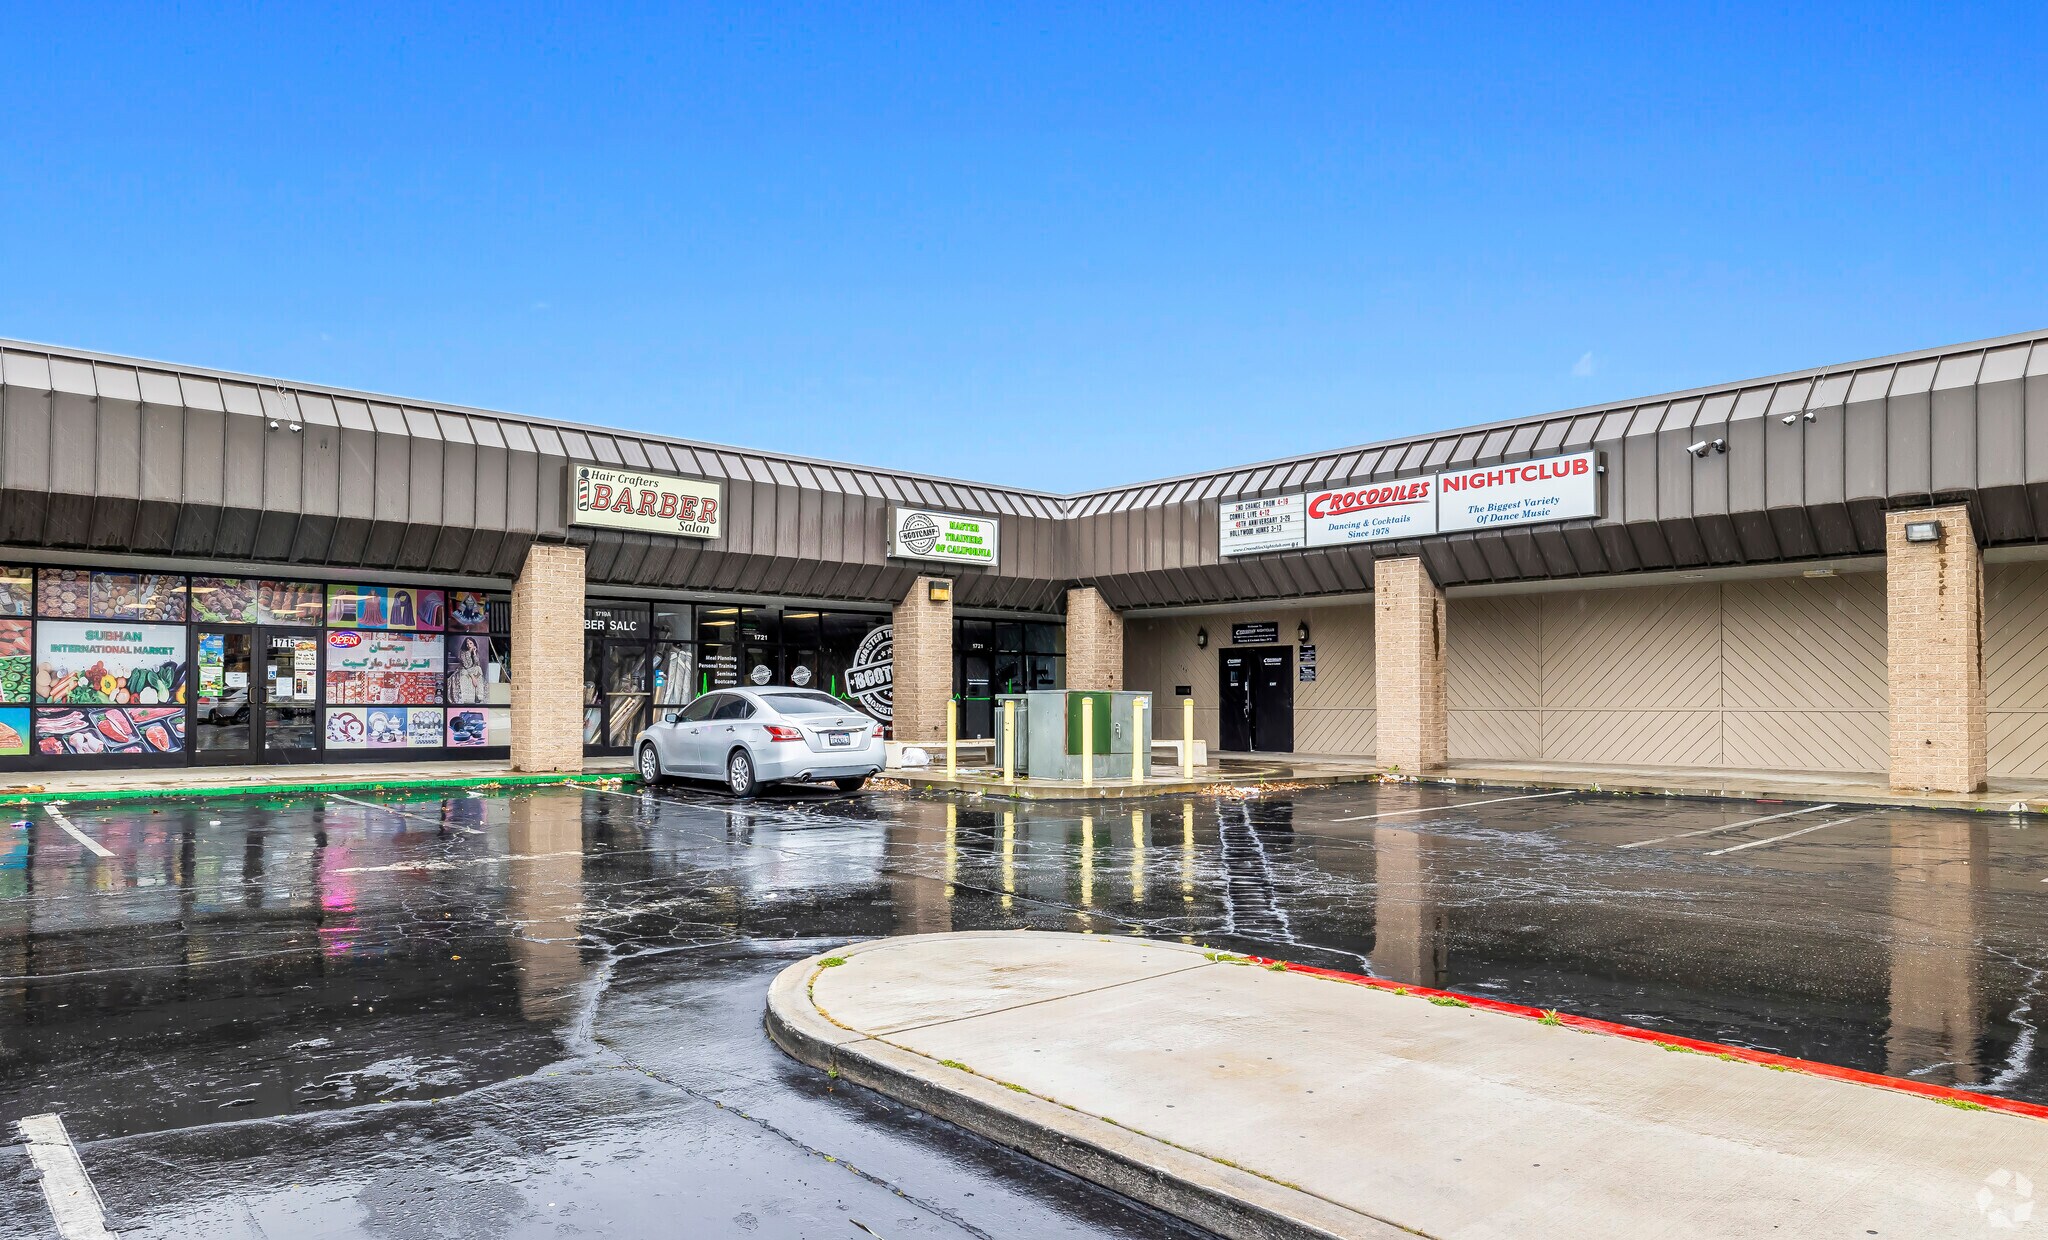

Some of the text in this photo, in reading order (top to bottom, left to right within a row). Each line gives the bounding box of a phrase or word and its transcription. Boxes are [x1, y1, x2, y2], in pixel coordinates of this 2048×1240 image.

[591, 470, 659, 488] Hair Crafters
[1443, 458, 1589, 493] NIGHTCLUB
[590, 484, 718, 524] BARBER
[1245, 502, 1261, 510] CHANCE
[1308, 481, 1430, 519] CROCODILES
[1468, 496, 1560, 514] The Biggest Variety
[1249, 516, 1278, 526] ANNIVERSARY
[1476, 508, 1550, 524] Of Dance Music
[678, 521, 710, 534] Salon
[949, 521, 979, 532] MASTER
[1328, 522, 1360, 531] Dancing
[1372, 515, 1410, 526] Cocktails
[903, 528, 935, 540] BOOTCAMP
[945, 533, 983, 544] TRAINERS
[1230, 528, 1254, 537] HOLLYWOOD
[1348, 527, 1390, 539] Since 1978
[935, 544, 991, 557] OF CALIFORNIA
[85, 630, 142, 642] SUBHAN
[330, 636, 358, 645] OPEN
[274, 639, 295, 647] 1715
[859, 632, 883, 665] MASTER
[50, 644, 174, 655] INTERNATIONAL MARKET
[854, 665, 893, 690] BOOT
